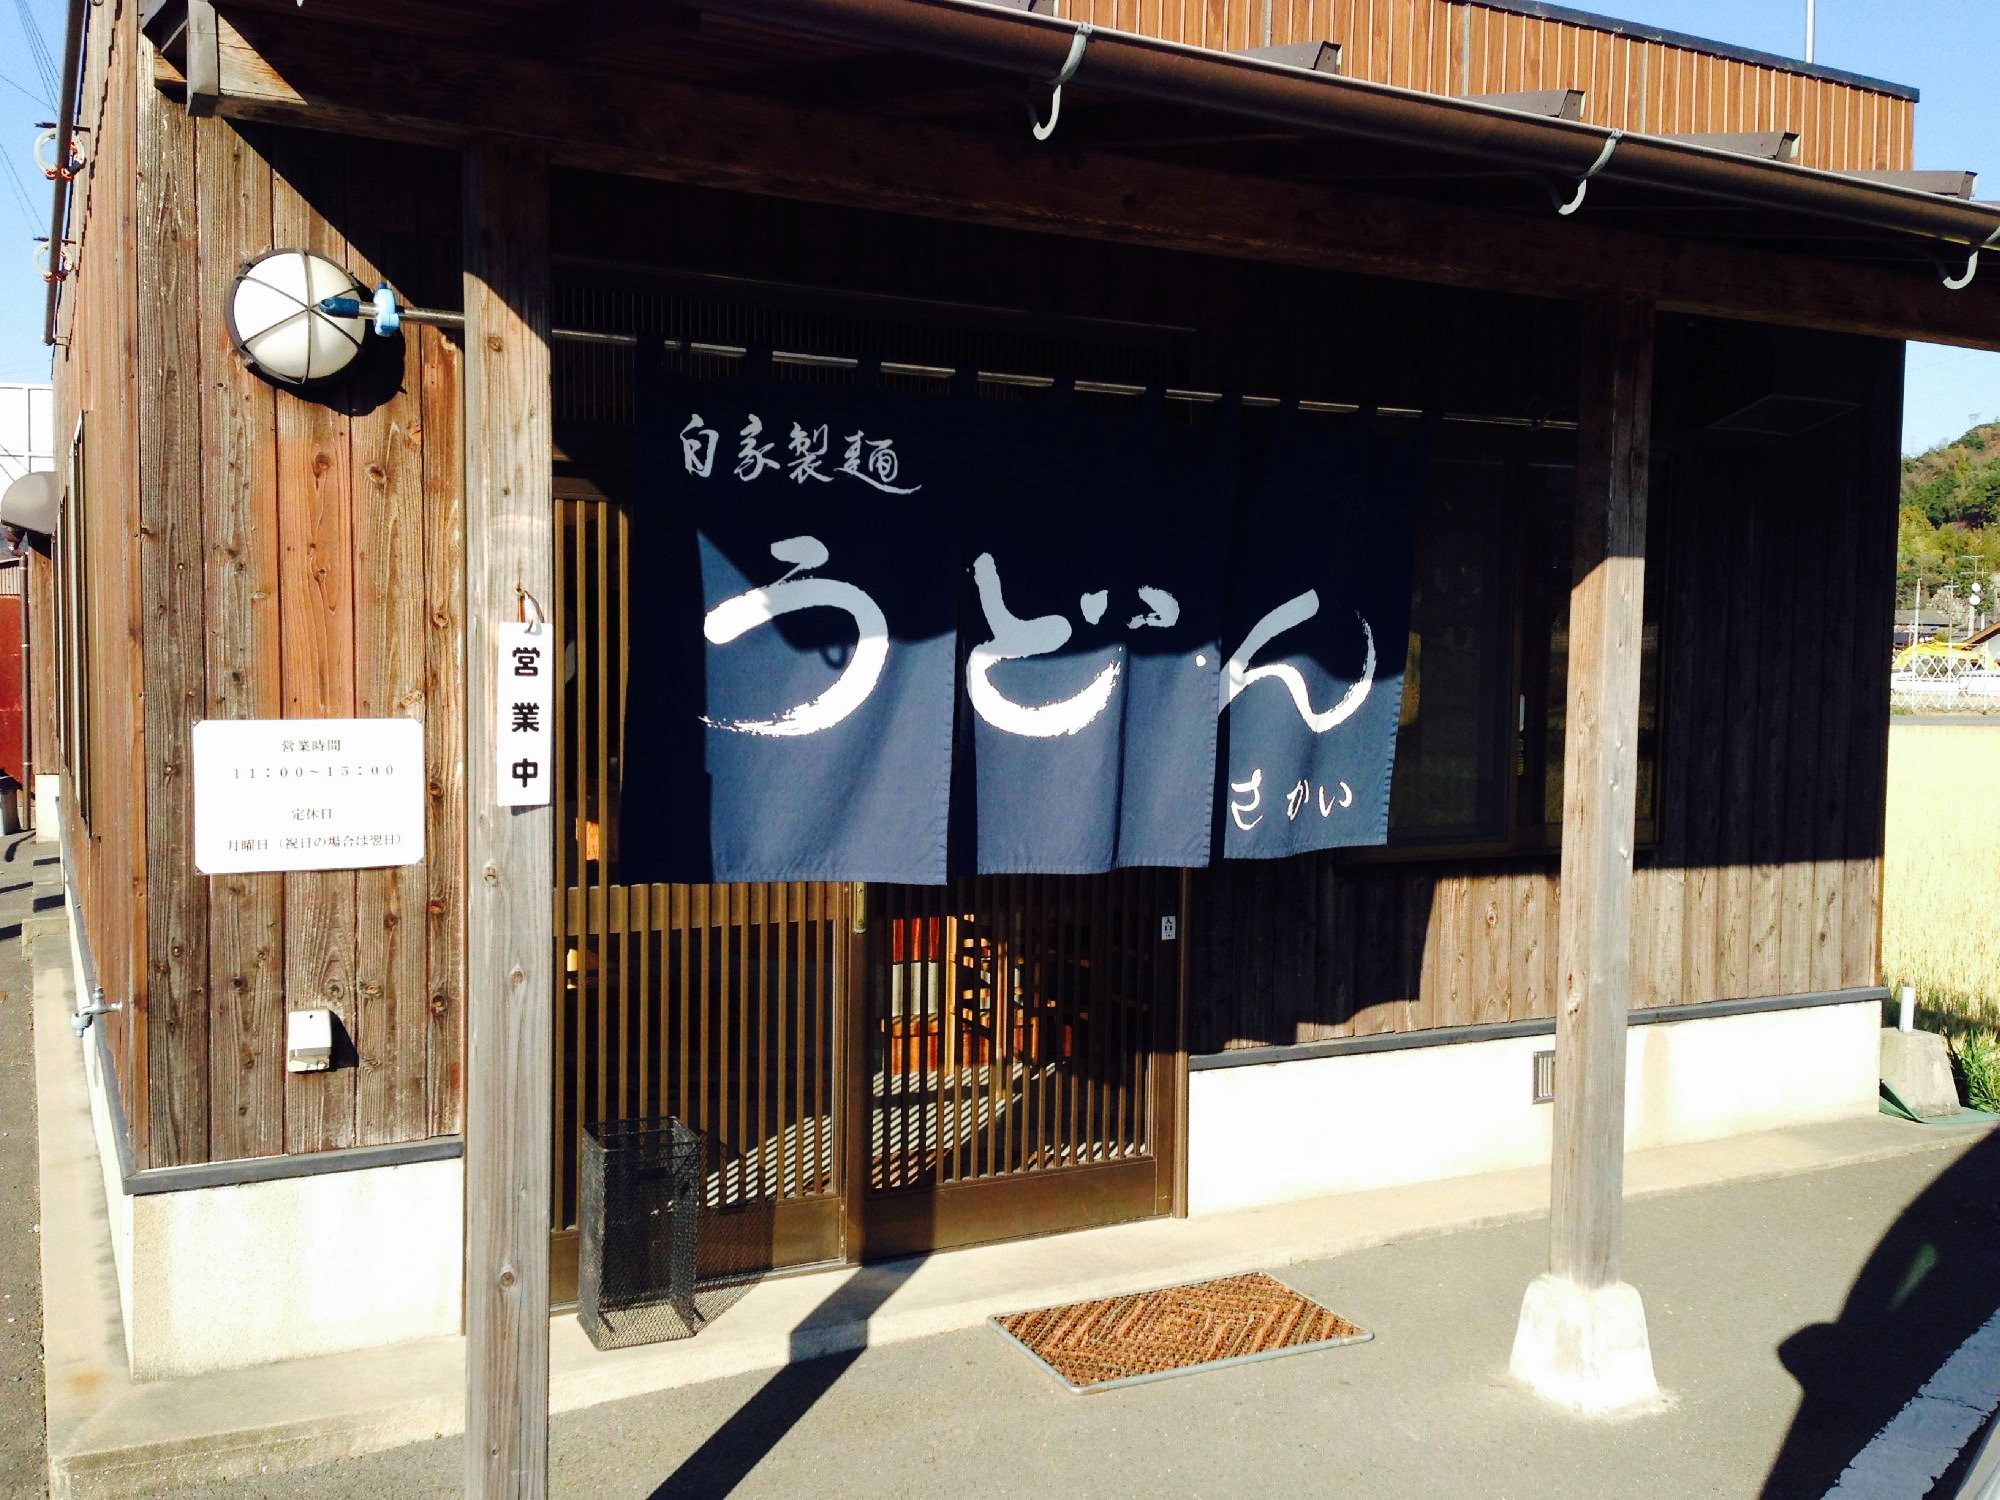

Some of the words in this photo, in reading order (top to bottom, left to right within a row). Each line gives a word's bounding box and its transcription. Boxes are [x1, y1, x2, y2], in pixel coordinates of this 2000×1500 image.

[680, 413, 922, 494] 自家製麺
[698, 535, 1376, 737] うどん
[282, 739, 341, 752] 営業時間
[512, 647, 540, 787] 営業中
[292, 808, 333, 821] 定休日
[1230, 769, 1353, 831] さかい
